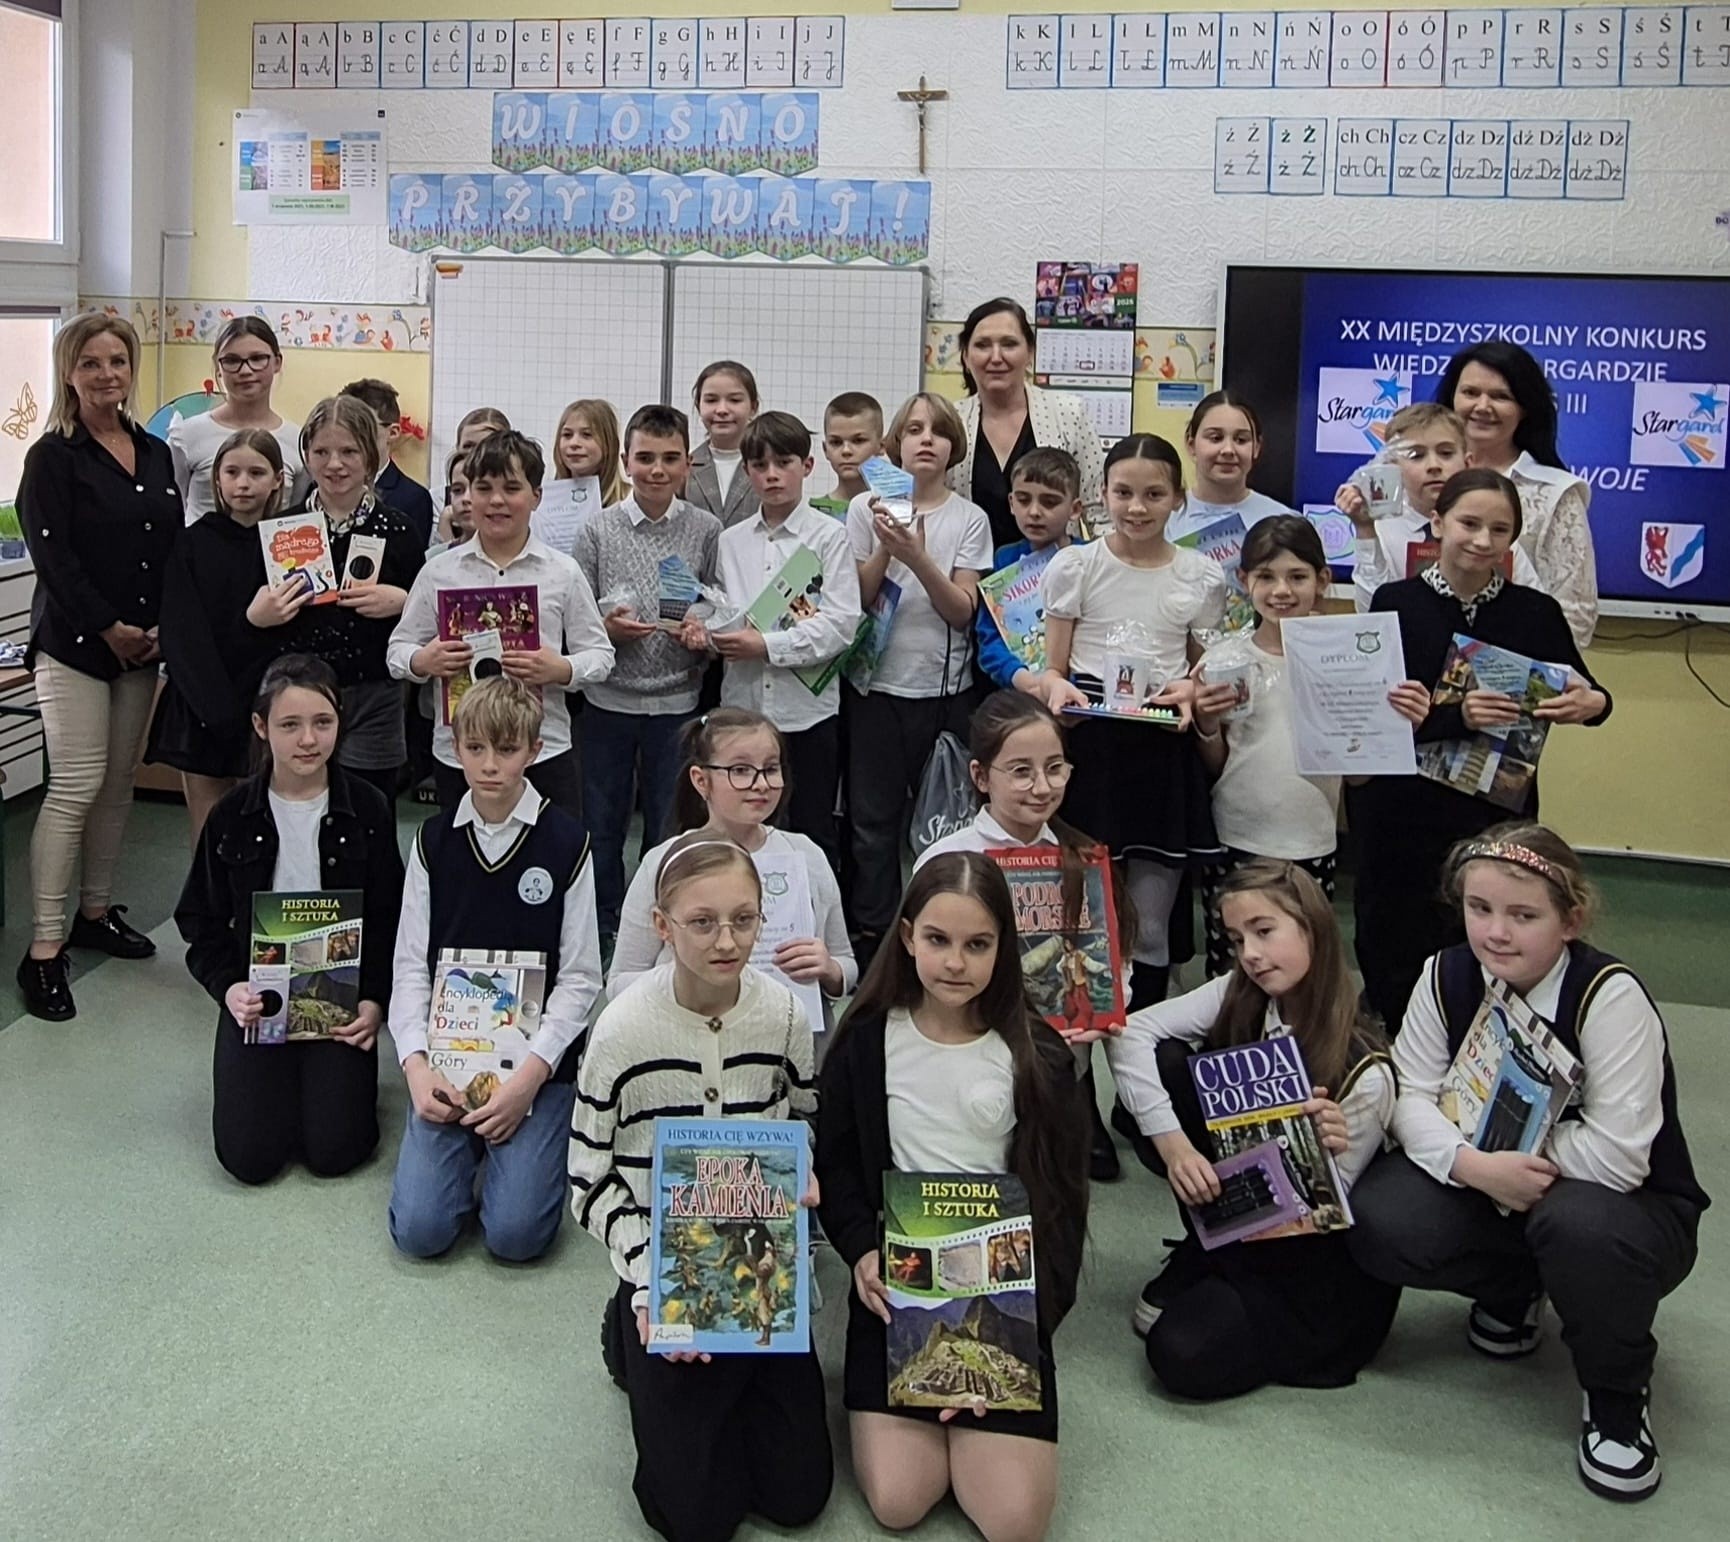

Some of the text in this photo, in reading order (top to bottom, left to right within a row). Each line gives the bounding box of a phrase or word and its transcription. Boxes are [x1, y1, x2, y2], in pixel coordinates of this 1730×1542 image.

[259, 25, 833, 50] a A ą Ą b B c C ć Ć d D e E ę Ę f F g G h H i I j J
[1016, 24, 1026, 39] k
[1038, 24, 1051, 38] K
[1092, 24, 1103, 38] L
[1172, 25, 1186, 37] m
[1198, 23, 1215, 36] M
[1230, 25, 1239, 36] n
[1253, 23, 1266, 36] N
[1285, 21, 1295, 36] ń
[1308, 16, 1322, 36] Ń
[1341, 25, 1351, 36] o
[1363, 21, 1377, 36] O
[1398, 19, 1408, 36] ó
[1421, 15, 1435, 36] Ó
[1457, 24, 1467, 39] p
[1482, 21, 1493, 34] P
[1516, 24, 1523, 34] r
[1538, 20, 1551, 34] R
[1575, 24, 1583, 34] s
[1599, 19, 1610, 33] S
[1635, 17, 1644, 34] ś
[1659, 12, 1671, 33] Ś
[1696, 20, 1703, 32] t
[501, 102, 806, 143] WIOSNO
[1341, 128, 1359, 143] ch
[1366, 128, 1389, 143] Ch
[1399, 132, 1417, 144] cz
[1423, 129, 1446, 145] Cz
[1455, 130, 1475, 145] dz
[1482, 130, 1505, 145] Dz
[1341, 319, 1707, 350] XX MIĘDZYSZKOLNY KONKURS
[1374, 353, 1669, 383] WIEDZ RGARDZIE
[1318, 396, 1394, 429] Stargar
[1633, 410, 1725, 443] Stargard
[1003, 571, 1041, 602] SIKOR
[281, 899, 340, 909] HISTORIA
[289, 912, 339, 922] SZTUKA
[438, 1002, 455, 1013] dla
[435, 1015, 479, 1030] Dzieci
[431, 1052, 468, 1069] Góry
[1195, 1042, 1297, 1091] CUDA
[1202, 1075, 1307, 1117] POLSKI
[668, 1129, 794, 1144] HISTORIA CIĘ WZYWA!
[696, 1156, 764, 1185] EPOKA
[669, 1184, 789, 1218] KAMIENIA
[921, 1182, 1000, 1198] HISTORIA
[923, 1202, 1000, 1217] I SZTUKA
